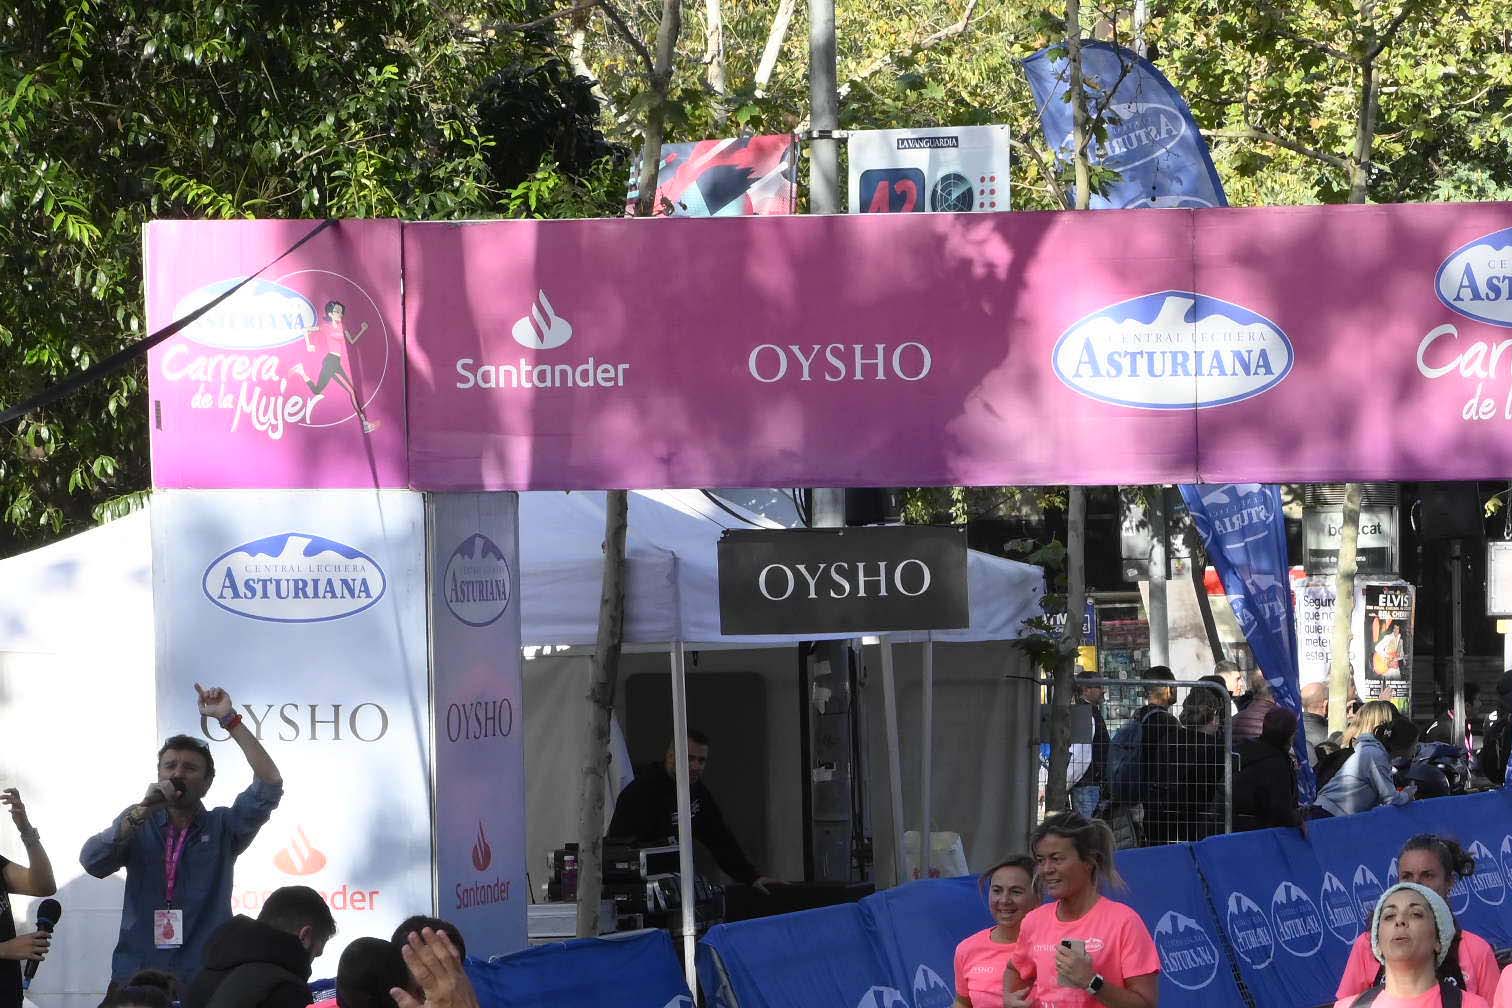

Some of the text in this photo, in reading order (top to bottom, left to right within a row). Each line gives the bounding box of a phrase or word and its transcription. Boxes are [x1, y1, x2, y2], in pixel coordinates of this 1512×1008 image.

[1191, 329, 1267, 344] LECHERA
[161, 344, 281, 381] Carrera
[456, 357, 630, 390] Santander
[748, 341, 932, 383] OYSHO
[1072, 335, 1275, 378] ASTURIANA
[191, 379, 325, 440] de la Mujer
[1462, 383, 1496, 421] de
[217, 565, 374, 600] ASTURIANA
[244, 562, 367, 574] CENTRAL LECHERA
[449, 567, 507, 602] ASTURIANA
[758, 558, 932, 601] OYSHO
[1378, 594, 1409, 607] ELVIS
[446, 698, 513, 743] OYSHO
[455, 876, 511, 910] Santander
